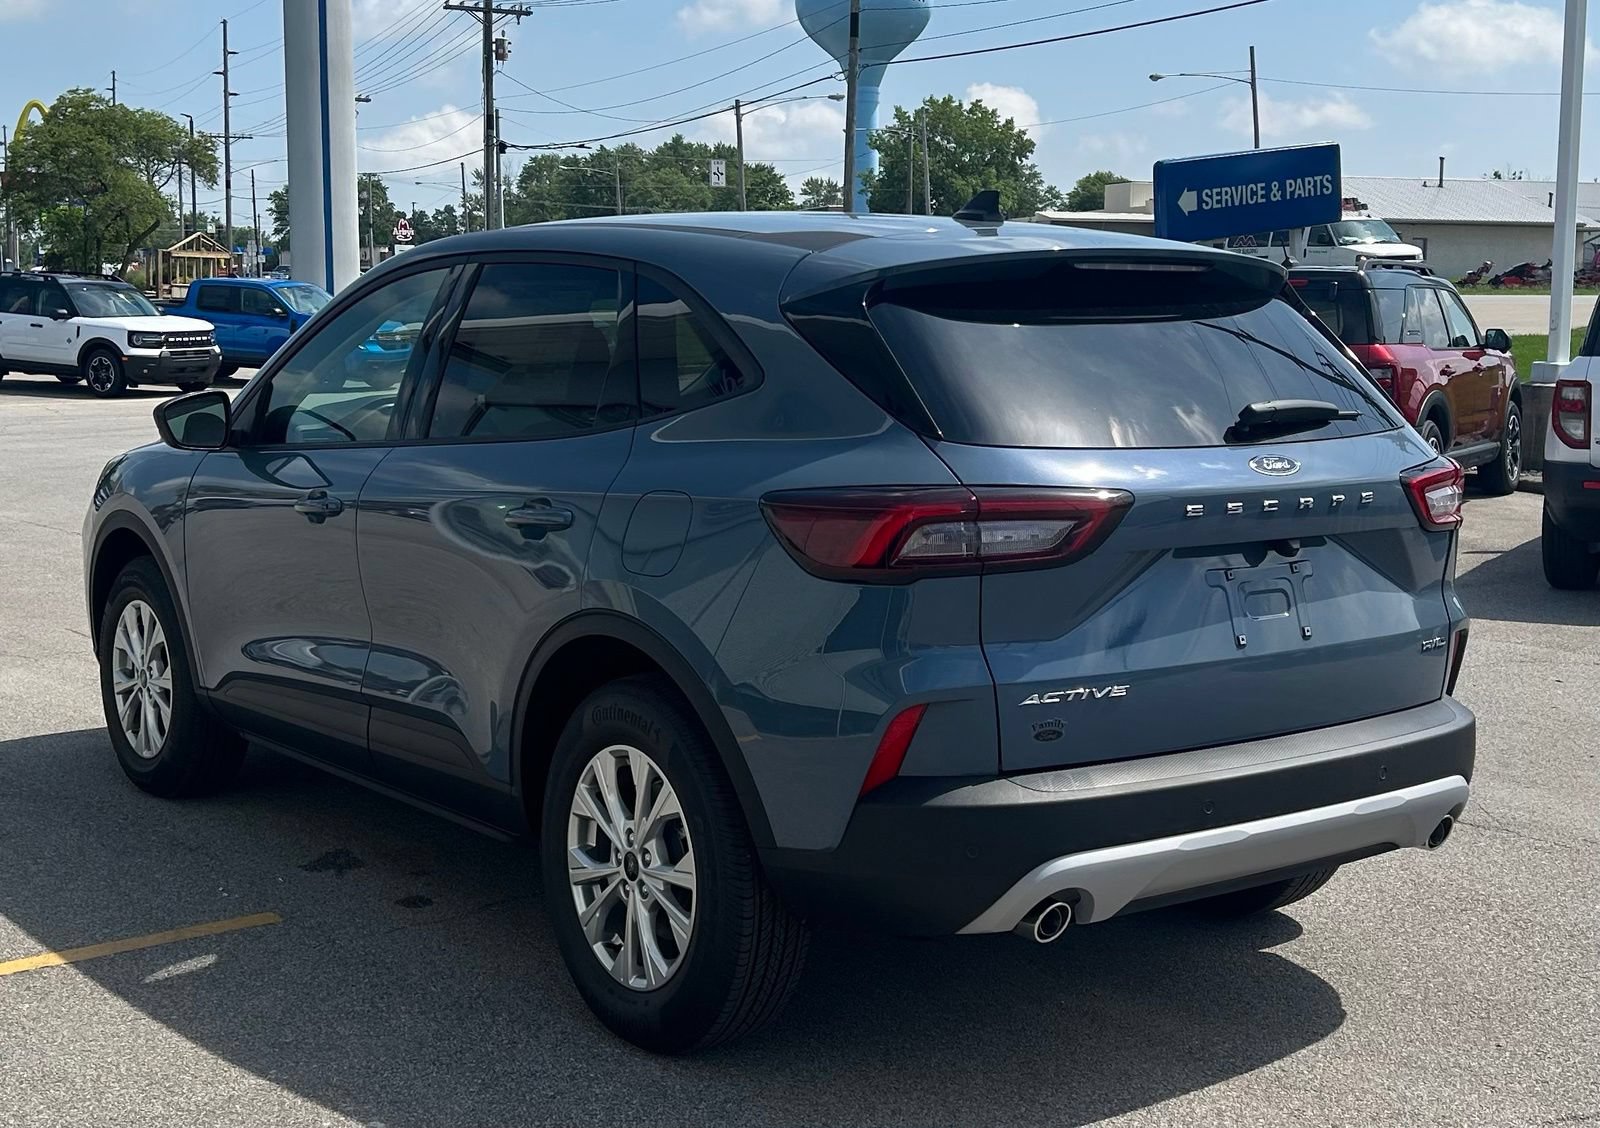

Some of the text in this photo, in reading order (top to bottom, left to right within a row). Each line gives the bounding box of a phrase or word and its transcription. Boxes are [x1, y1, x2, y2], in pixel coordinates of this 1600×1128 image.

[1201, 174, 1333, 211] SERVICE & PARTS
[1262, 456, 1292, 471] Ford
[1186, 491, 1374, 517] ESCAPE
[1018, 685, 1131, 706] ACTIVE
[592, 704, 655, 735] Continental
[1031, 718, 1067, 732] Family
